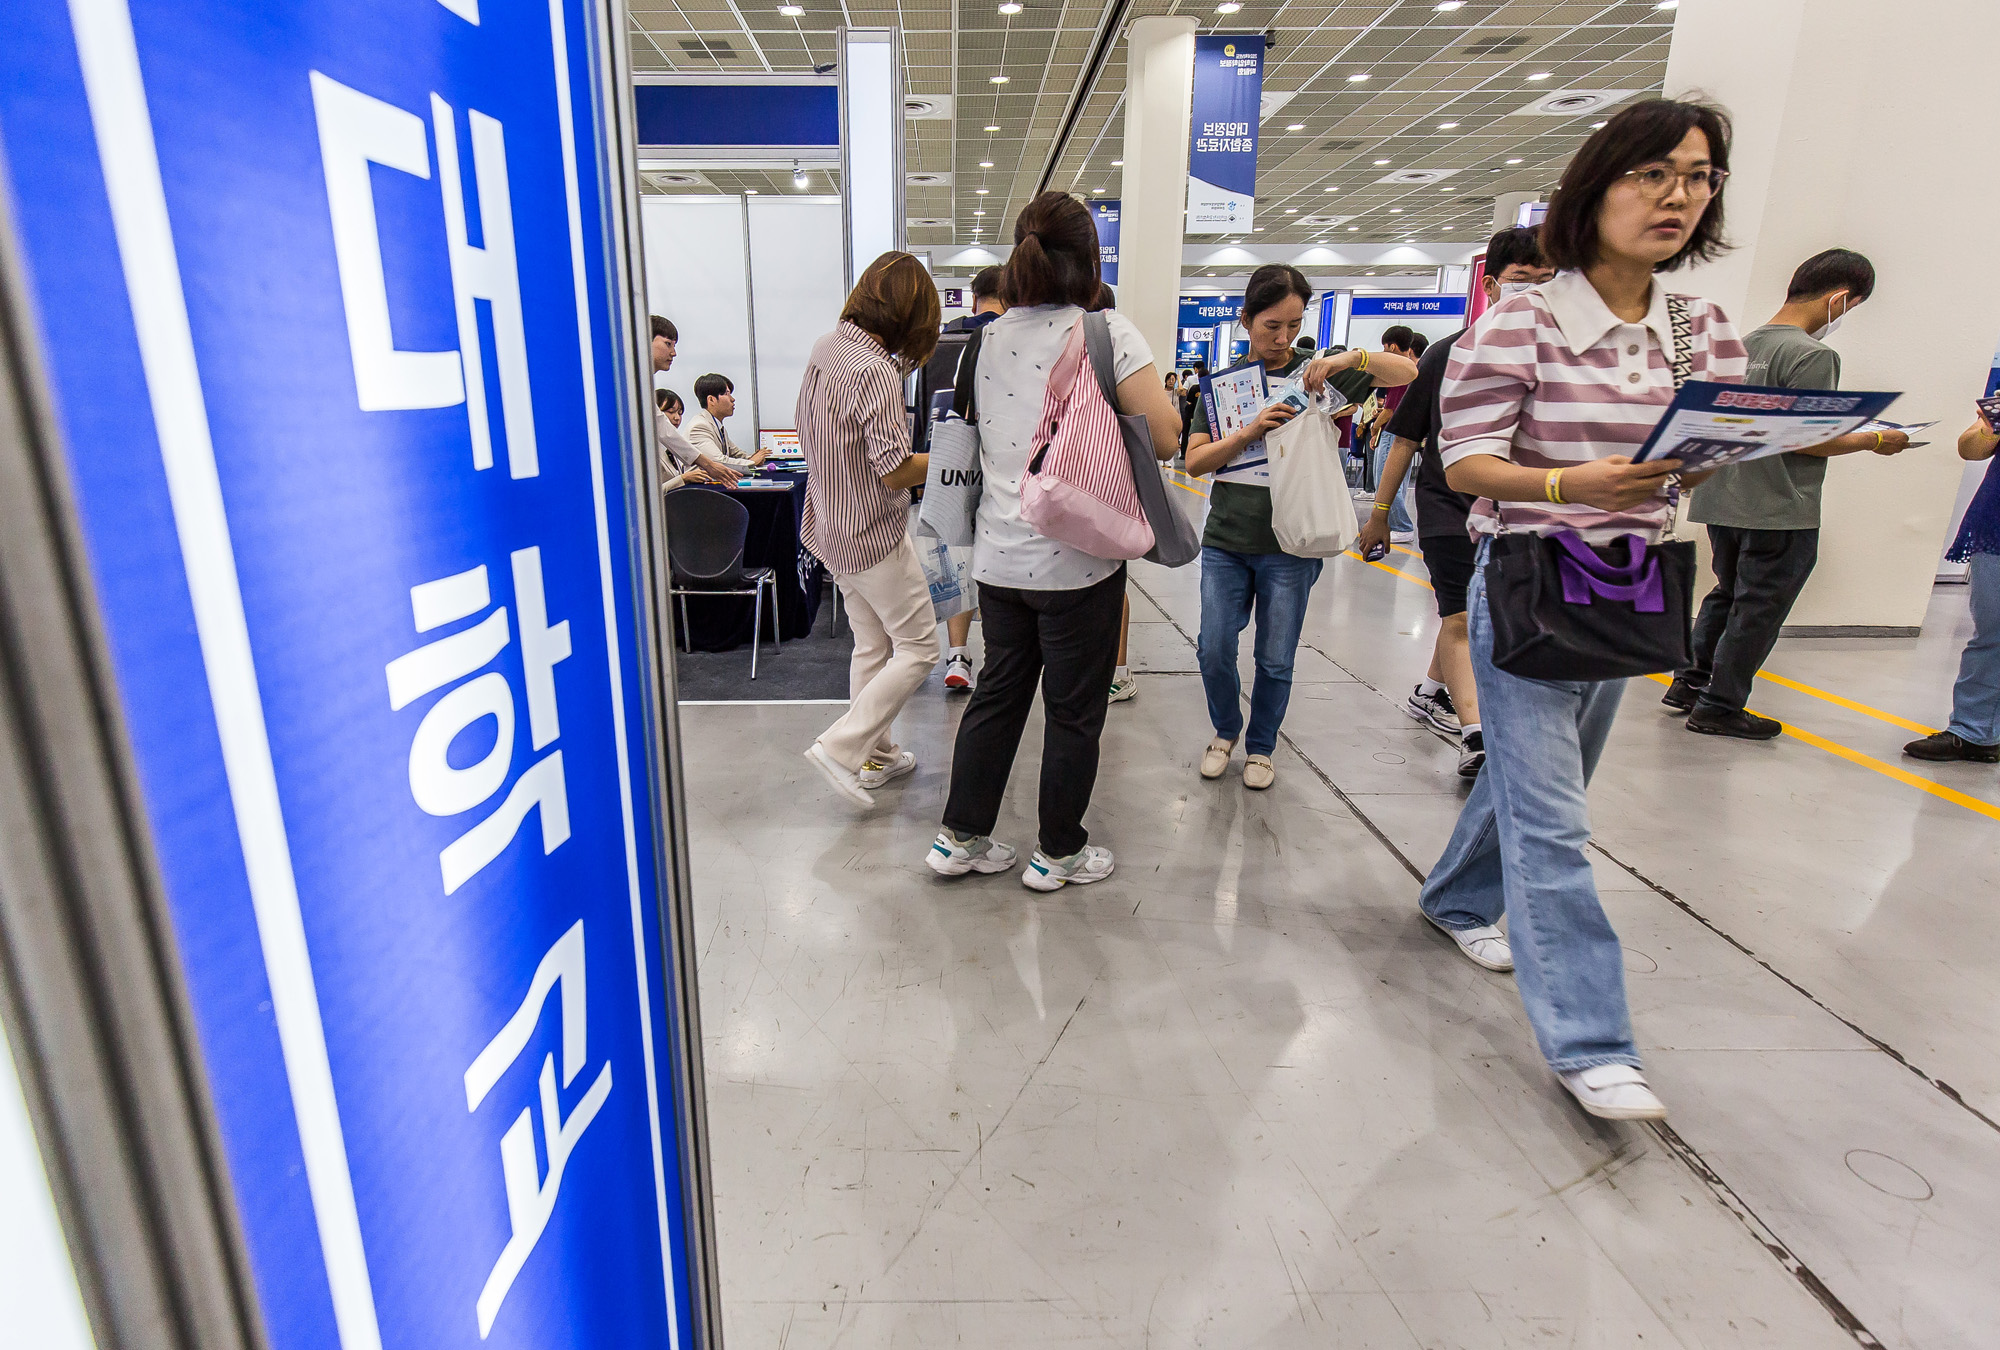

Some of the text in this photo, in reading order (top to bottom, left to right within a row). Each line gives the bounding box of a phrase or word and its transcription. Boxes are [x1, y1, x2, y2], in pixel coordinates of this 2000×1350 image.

[1198, 306, 1244, 317] 대입정보 종
[1383, 302, 1440, 311] 지역과 함께 100년
[309, 0, 613, 1341] 대학교
